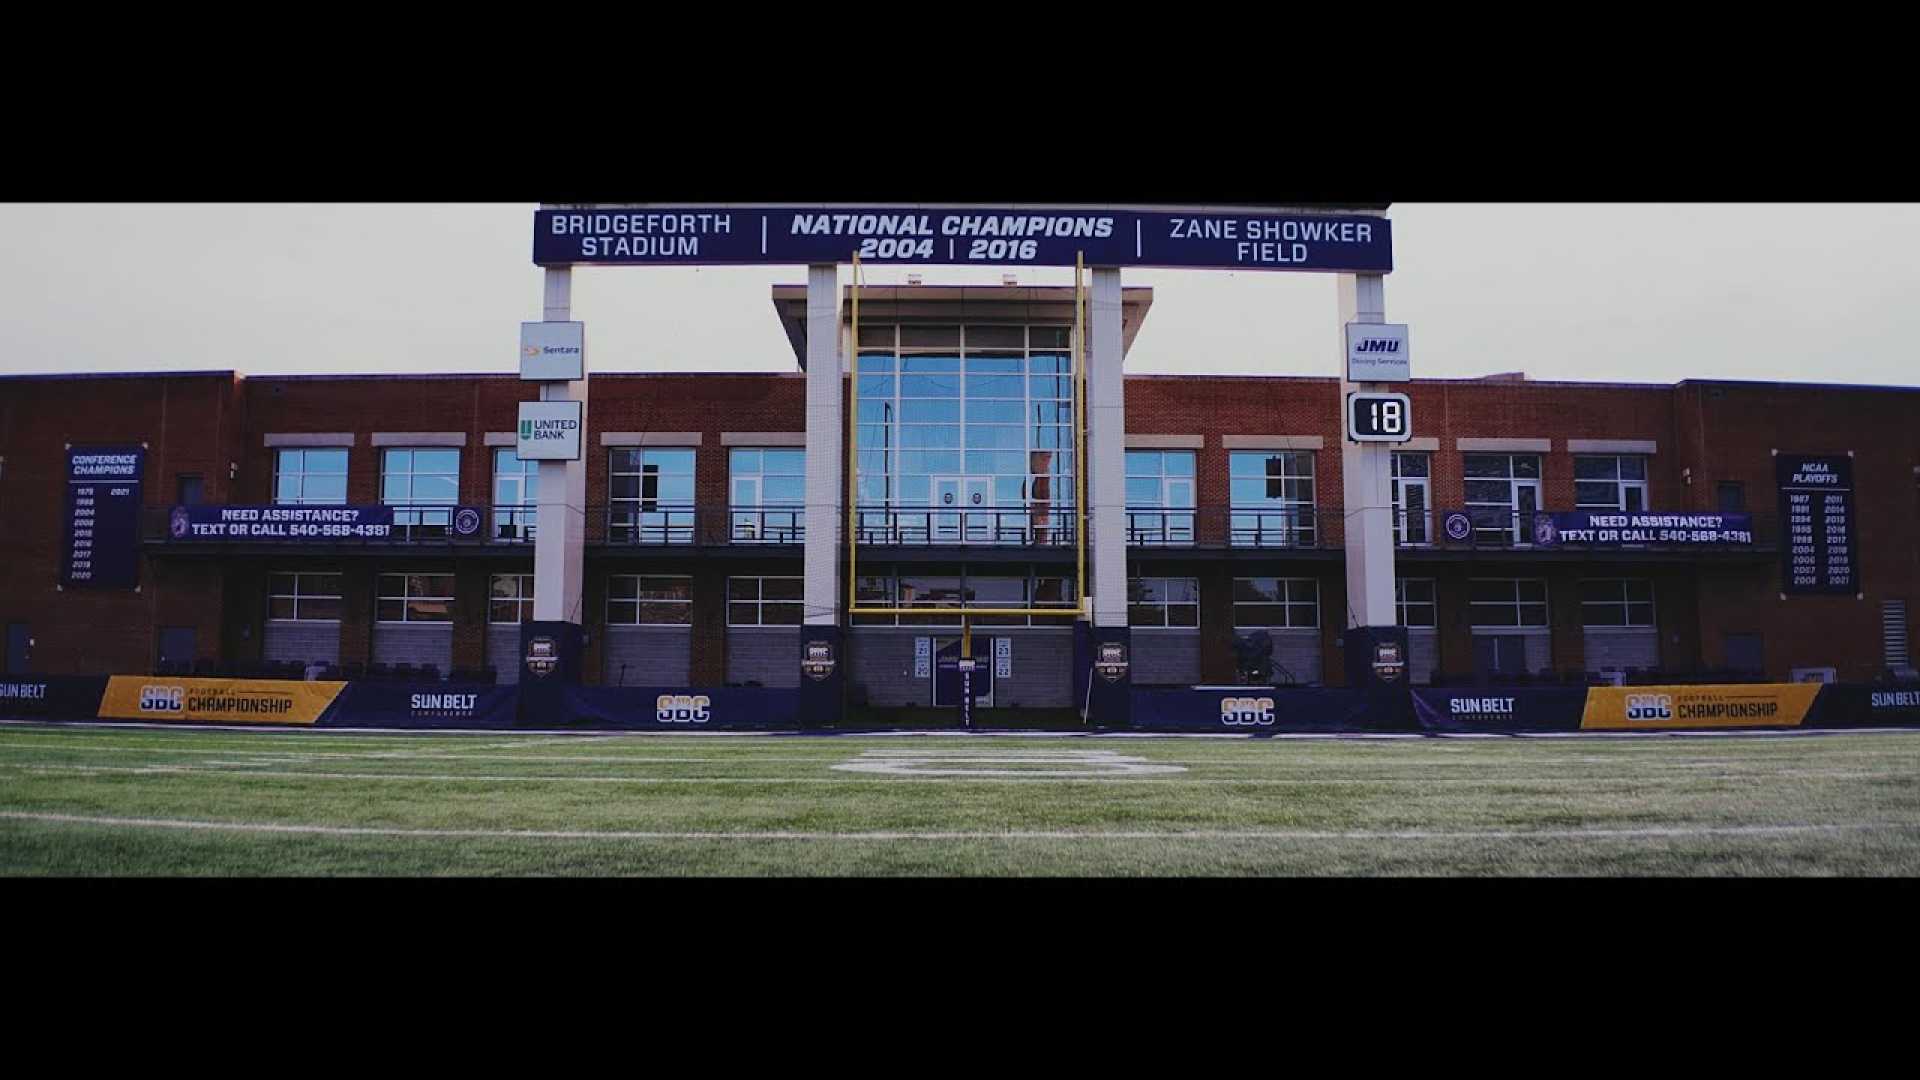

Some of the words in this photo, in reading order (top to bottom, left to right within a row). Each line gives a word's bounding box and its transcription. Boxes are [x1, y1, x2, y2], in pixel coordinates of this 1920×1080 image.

[551, 214, 730, 234] BRIDGEFORTH
[791, 214, 934, 235] NATIONAL
[941, 215, 1114, 238] CHAMPIONS
[1169, 218, 1238, 239] ZANE
[1246, 219, 1372, 242] SHOWKER
[581, 236, 699, 256] STADIUM
[858, 238, 934, 259] 2004
[968, 239, 1039, 260] 2016
[1237, 242, 1308, 262] FIELD
[543, 345, 580, 355] Sentara
[1356, 339, 1400, 352] JMU
[534, 419, 578, 430] UNITED
[1370, 401, 1402, 433] 18
[534, 430, 565, 440] BANK
[71, 455, 138, 465] CONFERENCE
[1801, 463, 1829, 472] NCAA
[73, 465, 136, 475] CHAMPIONS
[1791, 473, 1839, 483] PLAYOFFS
[221, 508, 260, 521] NEED
[262, 509, 360, 522] ASSISTANCE?
[1589, 514, 1628, 528] NEED
[1631, 515, 1723, 528] ASSISTANCE?
[191, 523, 226, 536] TEXT
[228, 524, 248, 536] OR
[251, 524, 287, 536] CALL
[289, 524, 391, 537] 540-568-4381
[1559, 530, 1596, 542] TEXT
[1598, 530, 1619, 542] OR
[1621, 530, 1658, 542] CALL
[1659, 530, 1752, 545] 540-568-4381
[20, 684, 47, 699] BELT
[139, 684, 184, 712] SBC
[1871, 691, 1894, 706] SUN
[1895, 690, 1920, 706] BELT
[188, 696, 293, 714] CHAMPIONSHIP
[410, 694, 441, 709] SUN
[443, 693, 478, 709] BELT
[656, 695, 711, 723] SBC
[1450, 698, 1480, 713] SUN
[1481, 698, 1515, 713] BELT
[1625, 694, 1673, 720] SBC
[1221, 697, 1276, 726] SBC
[1678, 702, 1778, 719] CHAMPIONSHIP
